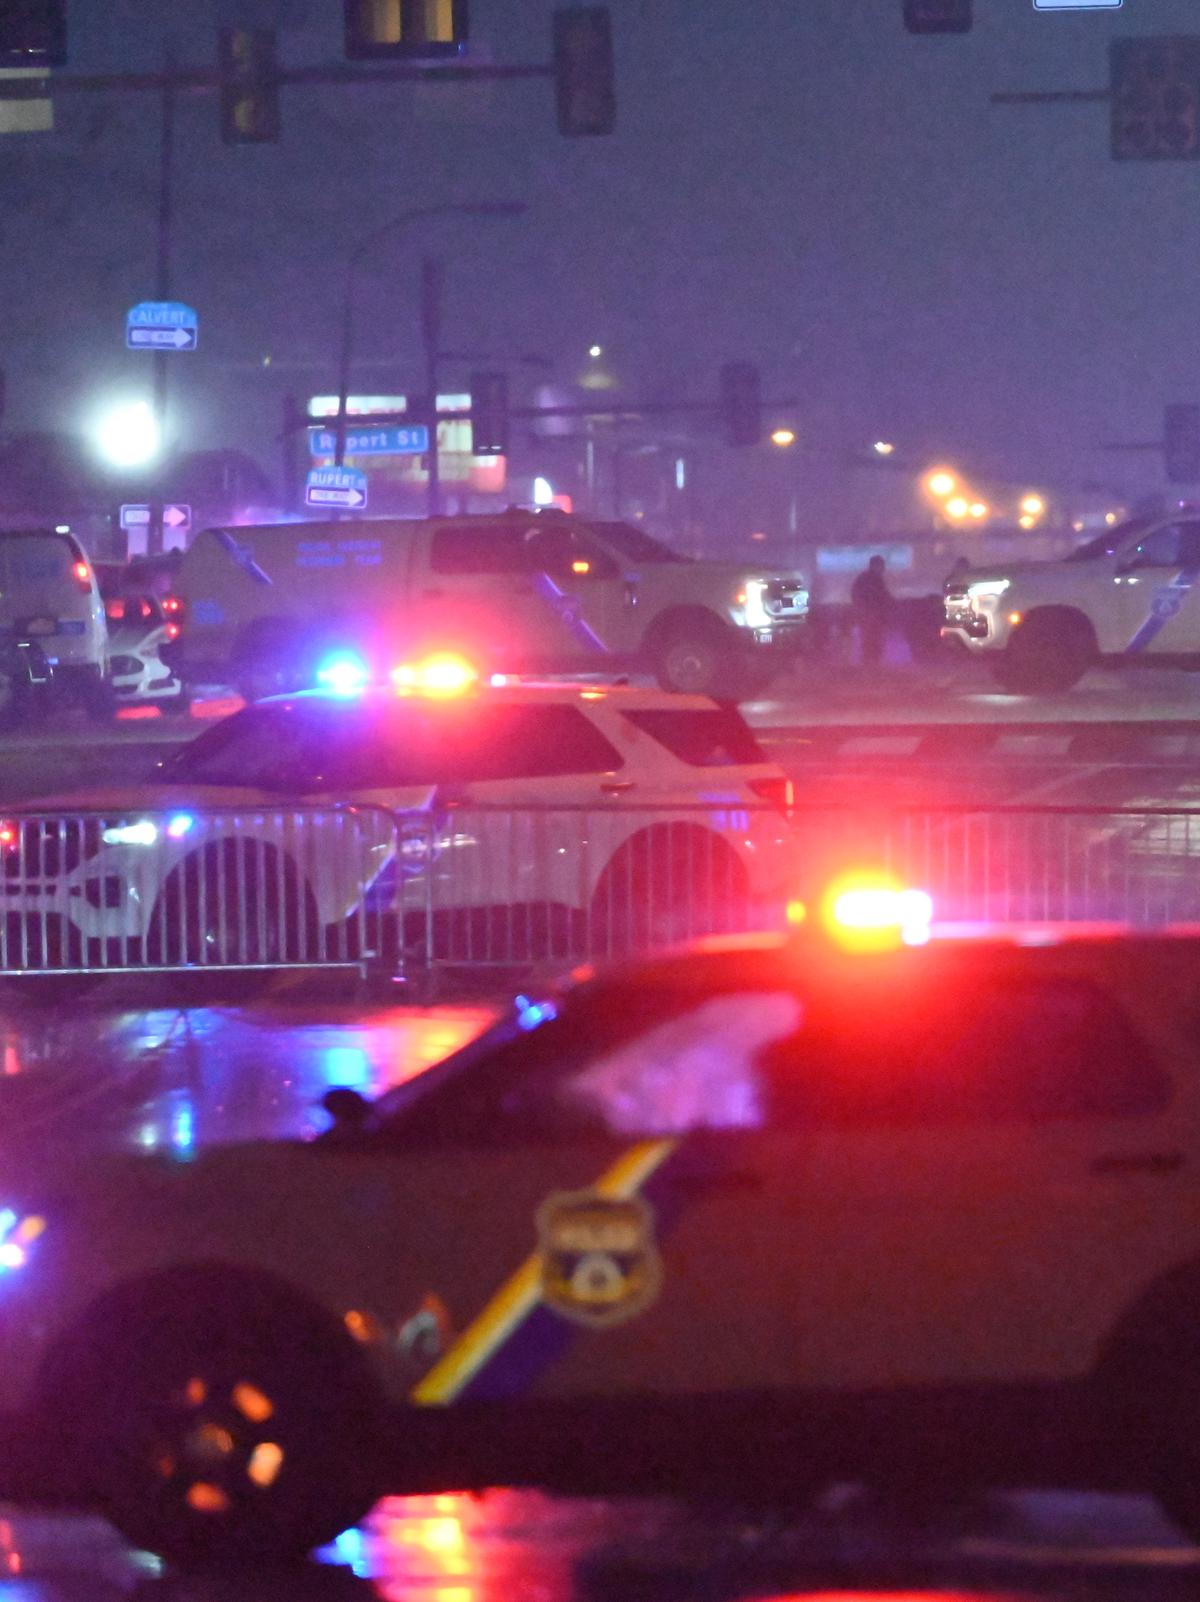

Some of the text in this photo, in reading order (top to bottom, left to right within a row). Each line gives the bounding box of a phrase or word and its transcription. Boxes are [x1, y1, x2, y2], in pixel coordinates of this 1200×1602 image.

[319, 430, 418, 450] Rpert St
[310, 471, 355, 486] RUPERT
